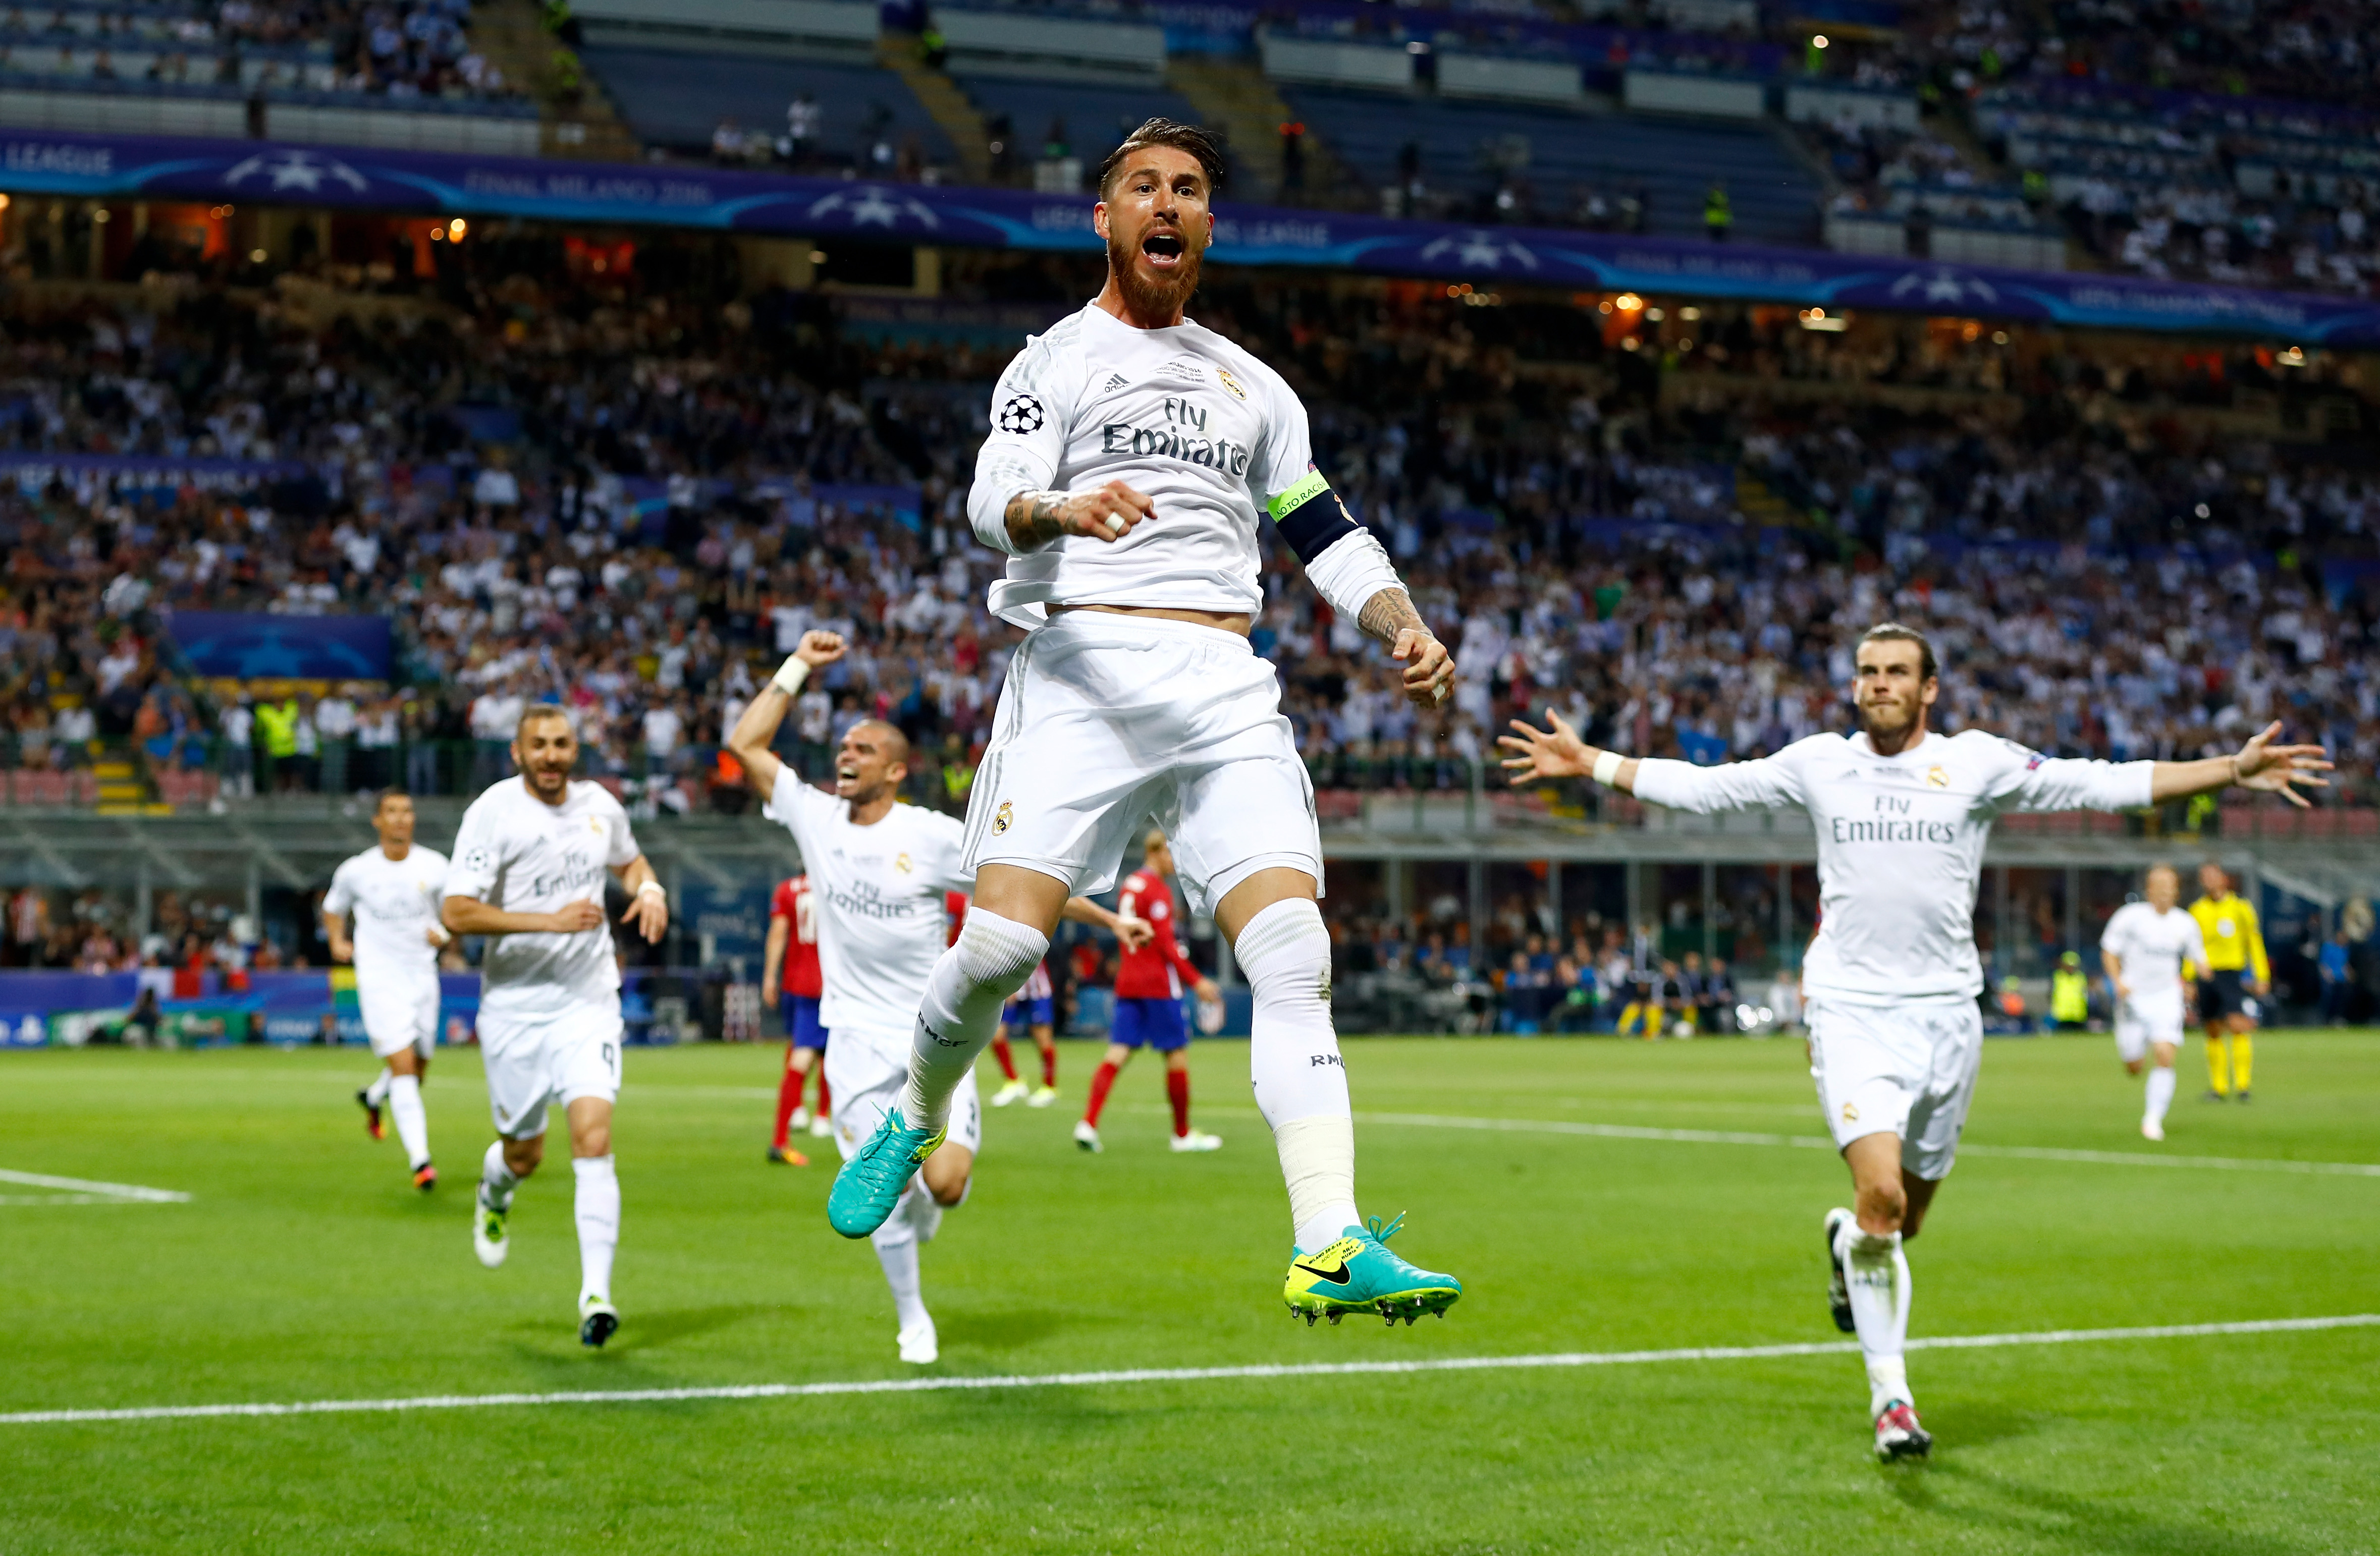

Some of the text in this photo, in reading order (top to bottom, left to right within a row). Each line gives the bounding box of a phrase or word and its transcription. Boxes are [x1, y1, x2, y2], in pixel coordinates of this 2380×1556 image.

[6, 141, 112, 176] LEAGUE
[1163, 397, 1207, 431] Fly
[1276, 507, 1287, 518] NO
[1286, 498, 1299, 509] TO
[1874, 795, 1911, 814] Fly
[1832, 814, 1955, 844] Emirates
[918, 1010, 969, 1047] RMCF
